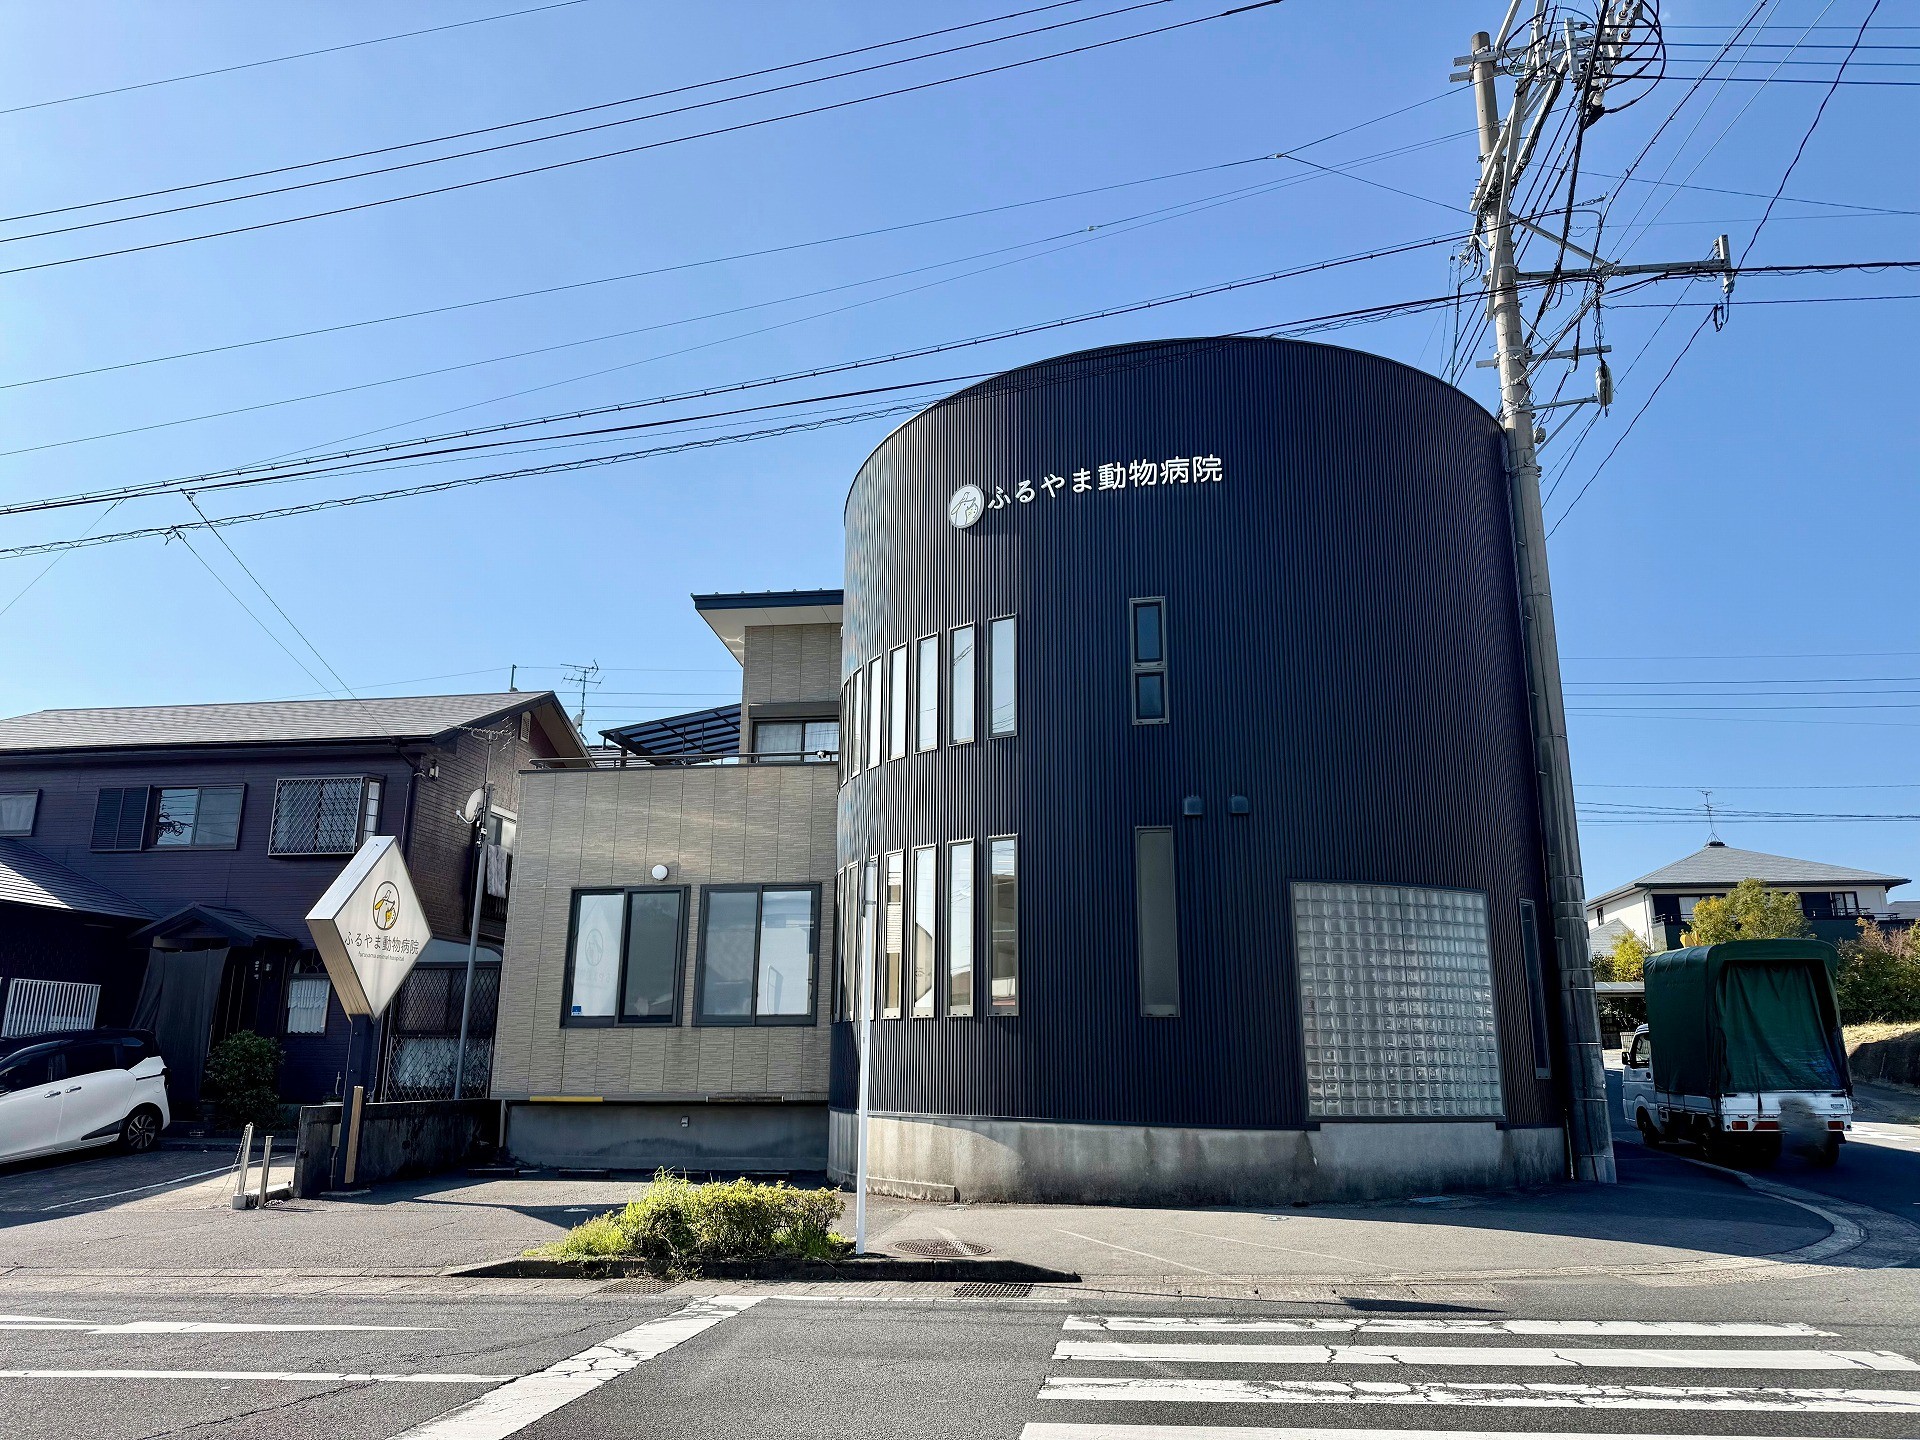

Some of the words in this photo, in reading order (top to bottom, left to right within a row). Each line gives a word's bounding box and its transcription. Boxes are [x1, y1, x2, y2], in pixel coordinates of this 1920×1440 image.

[987, 453, 1223, 510] ふるやま動物病院
[344, 931, 420, 955] ふるやま動物病院
